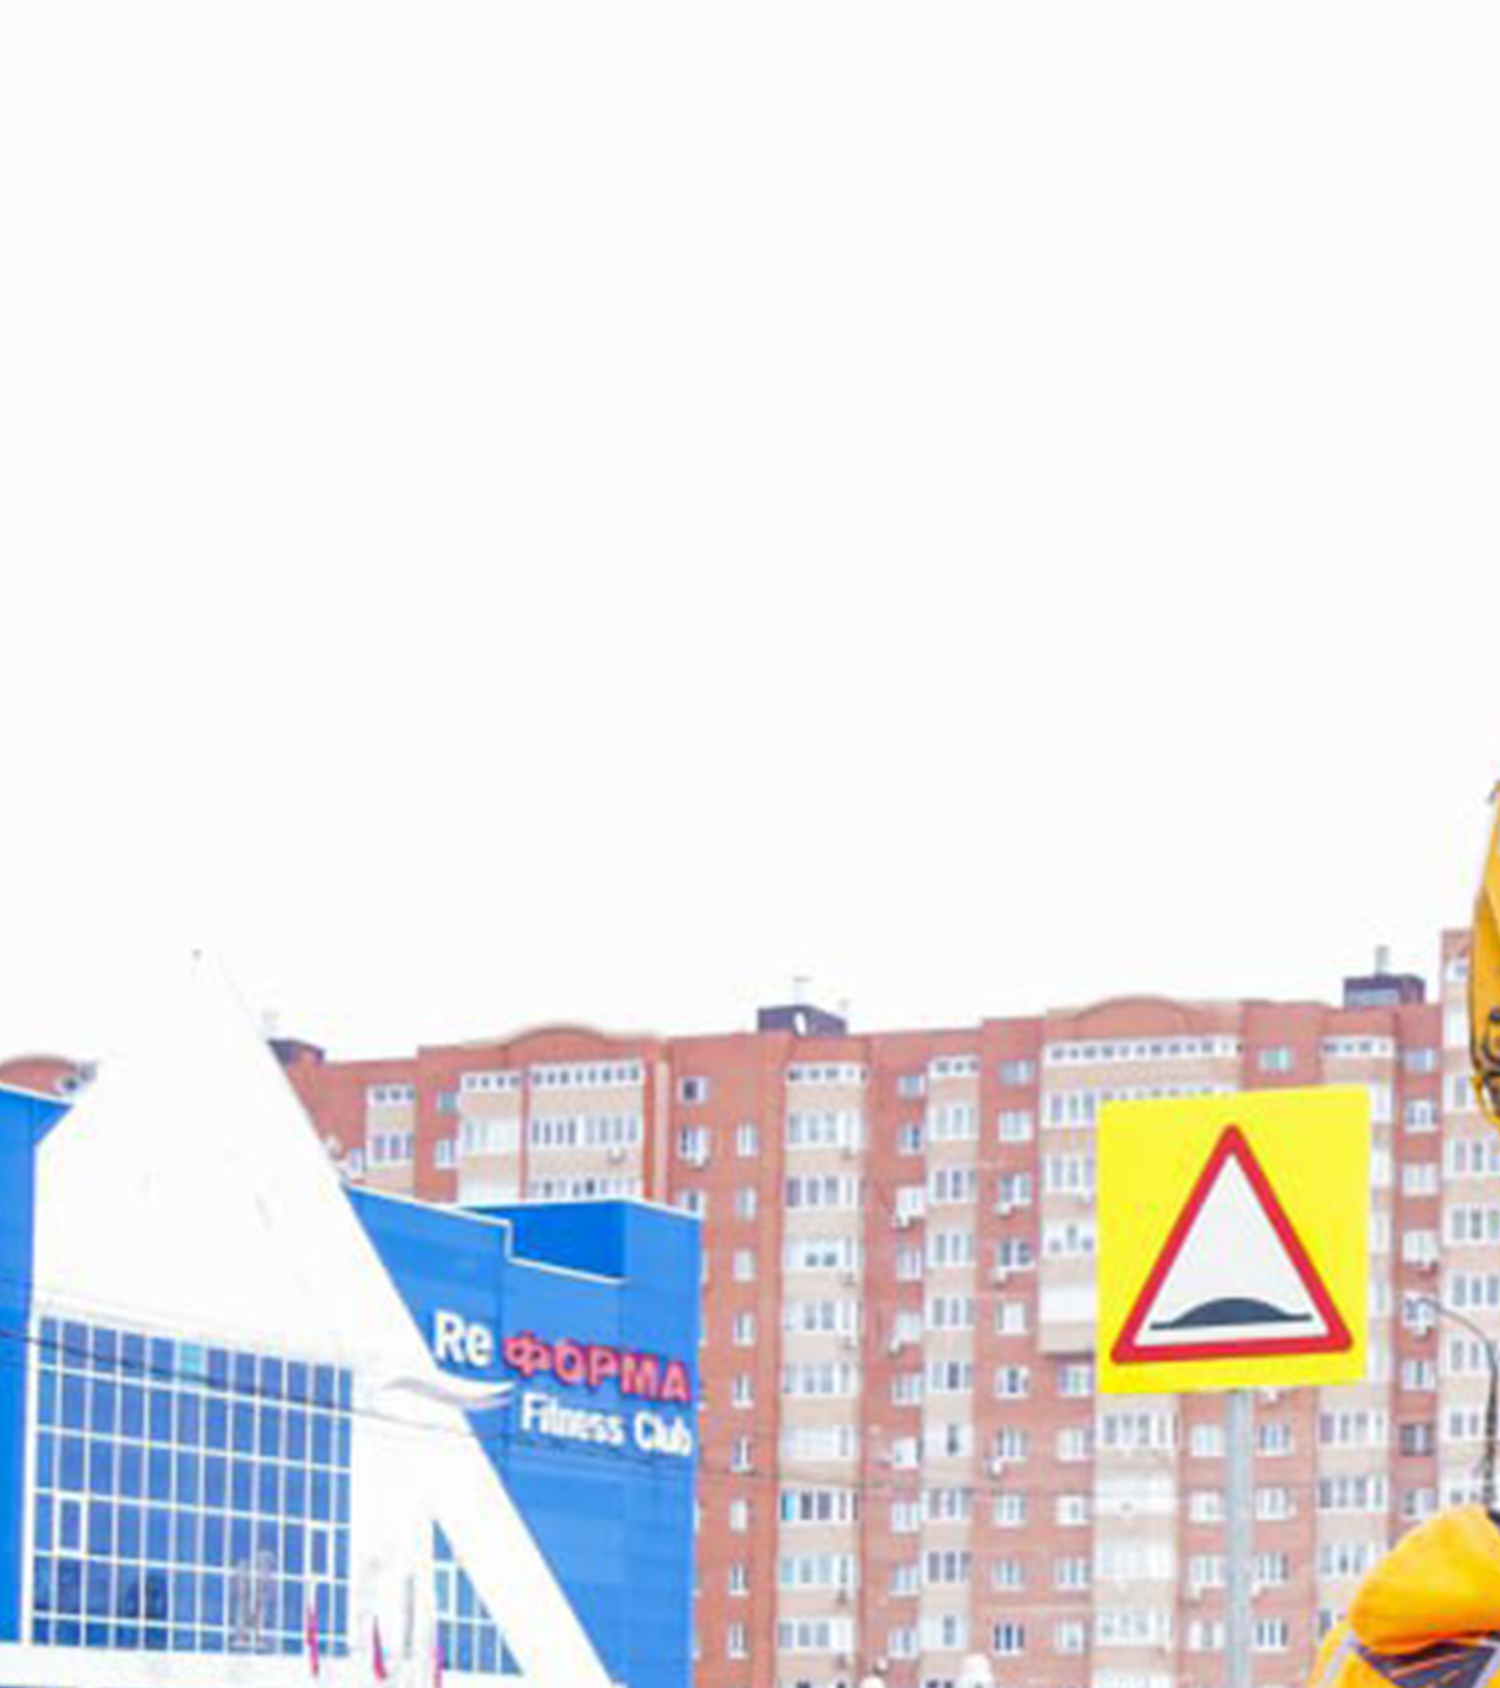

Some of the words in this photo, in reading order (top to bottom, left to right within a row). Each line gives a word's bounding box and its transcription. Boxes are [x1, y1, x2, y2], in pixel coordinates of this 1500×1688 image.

[434, 1309, 494, 1367] Re
[521, 1392, 626, 1446] Fitness
[634, 1411, 693, 1456] Club
